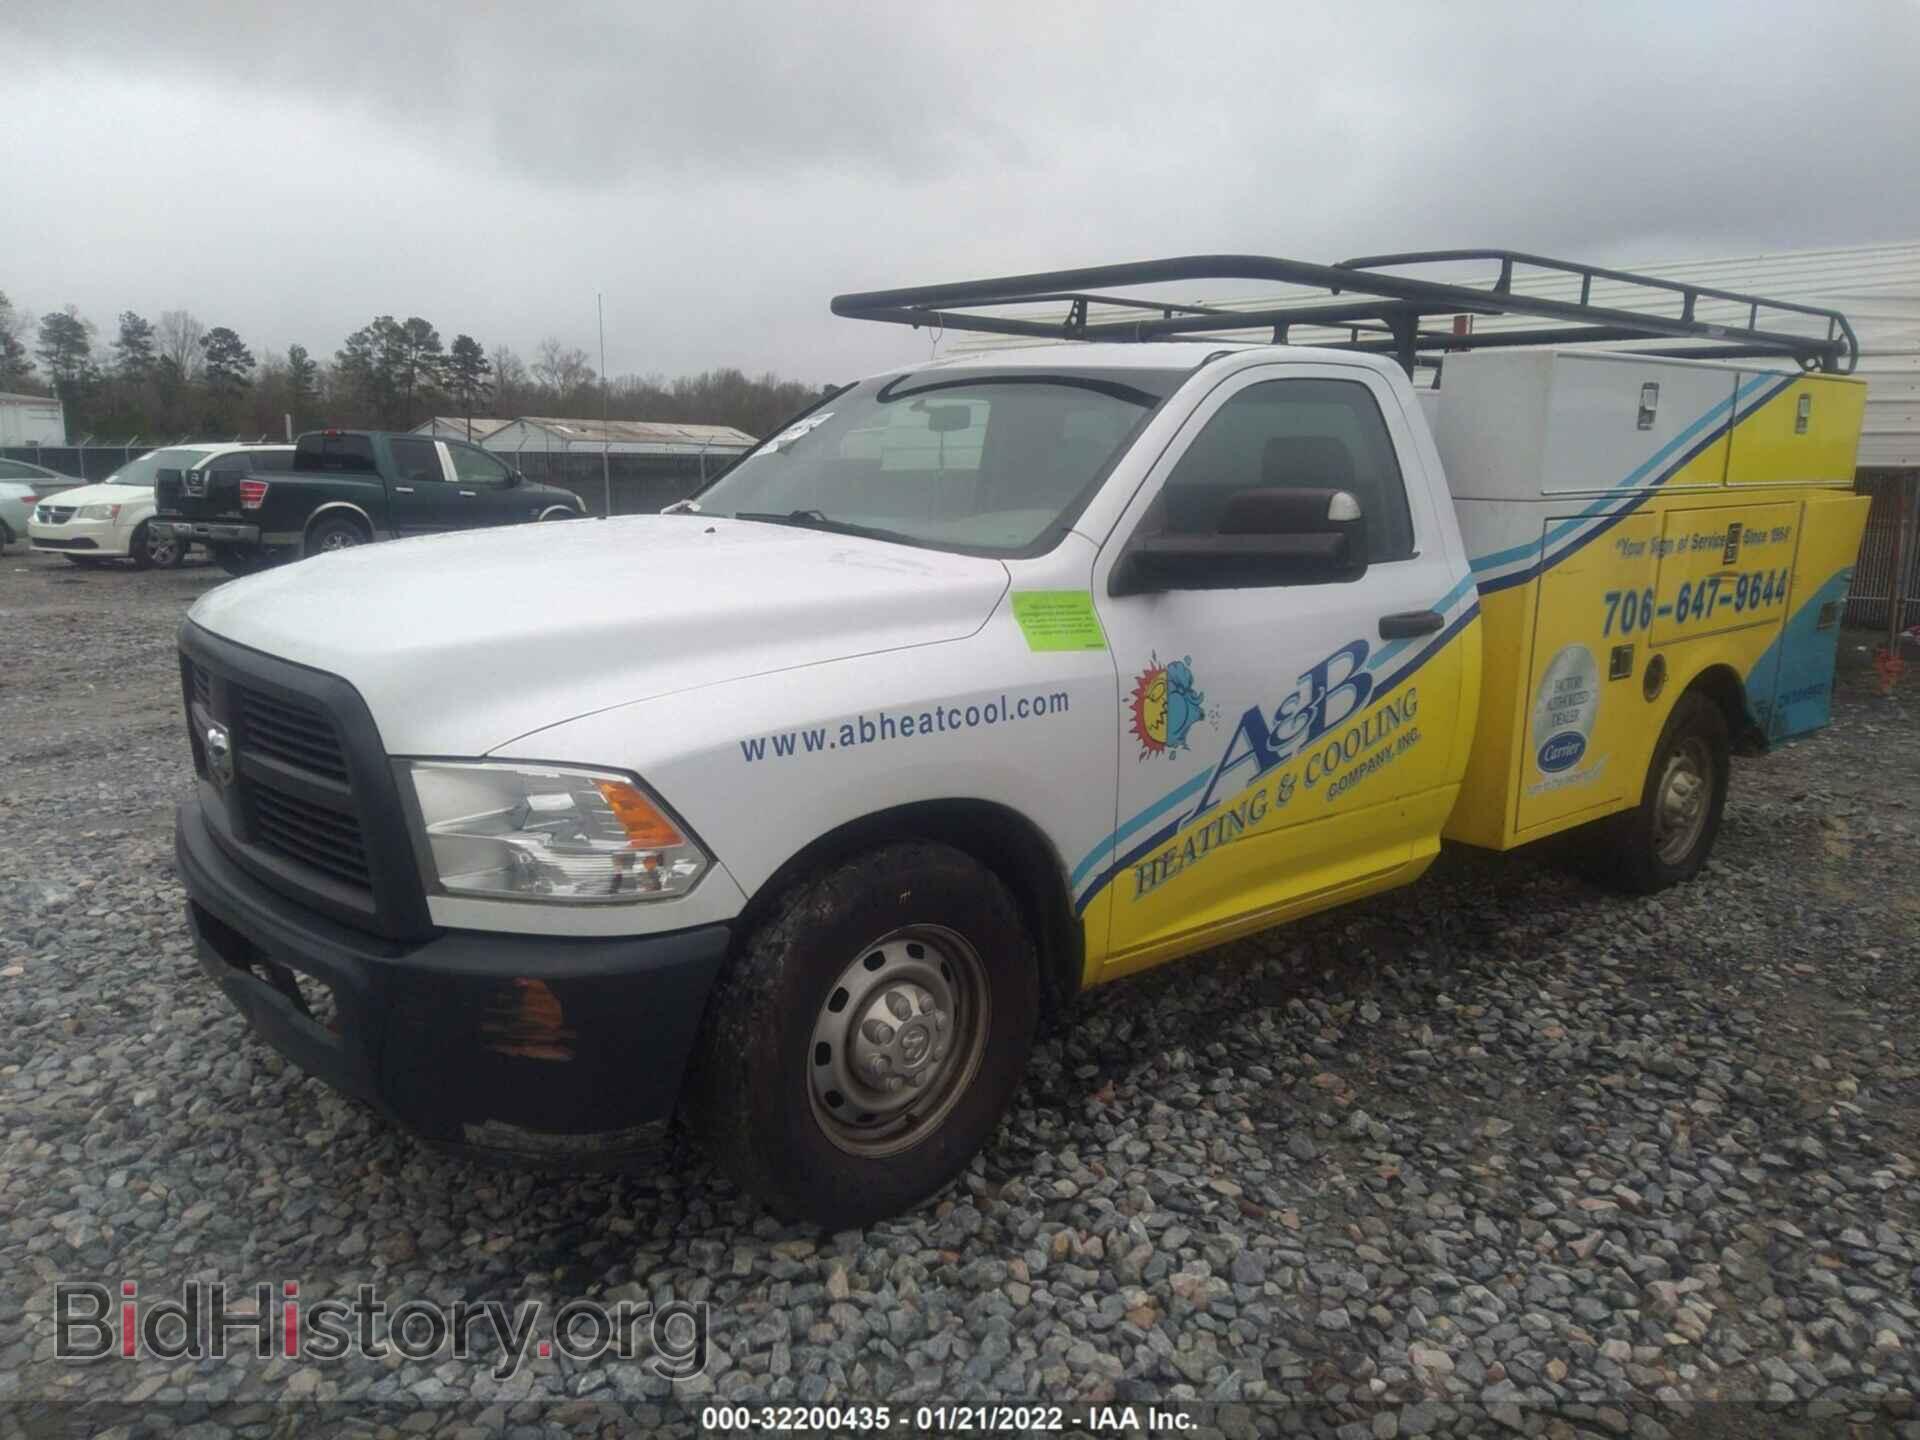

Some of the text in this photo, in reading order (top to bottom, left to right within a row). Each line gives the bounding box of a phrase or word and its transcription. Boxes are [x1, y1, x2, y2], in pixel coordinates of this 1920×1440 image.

[1603, 568, 1788, 638] 706-647-9644
[740, 691, 1070, 762] www.abheatcool.com
[1544, 741, 1581, 763] Carrier
[1134, 788, 1271, 900] HEATING
[1304, 687, 1420, 787] COOLING
